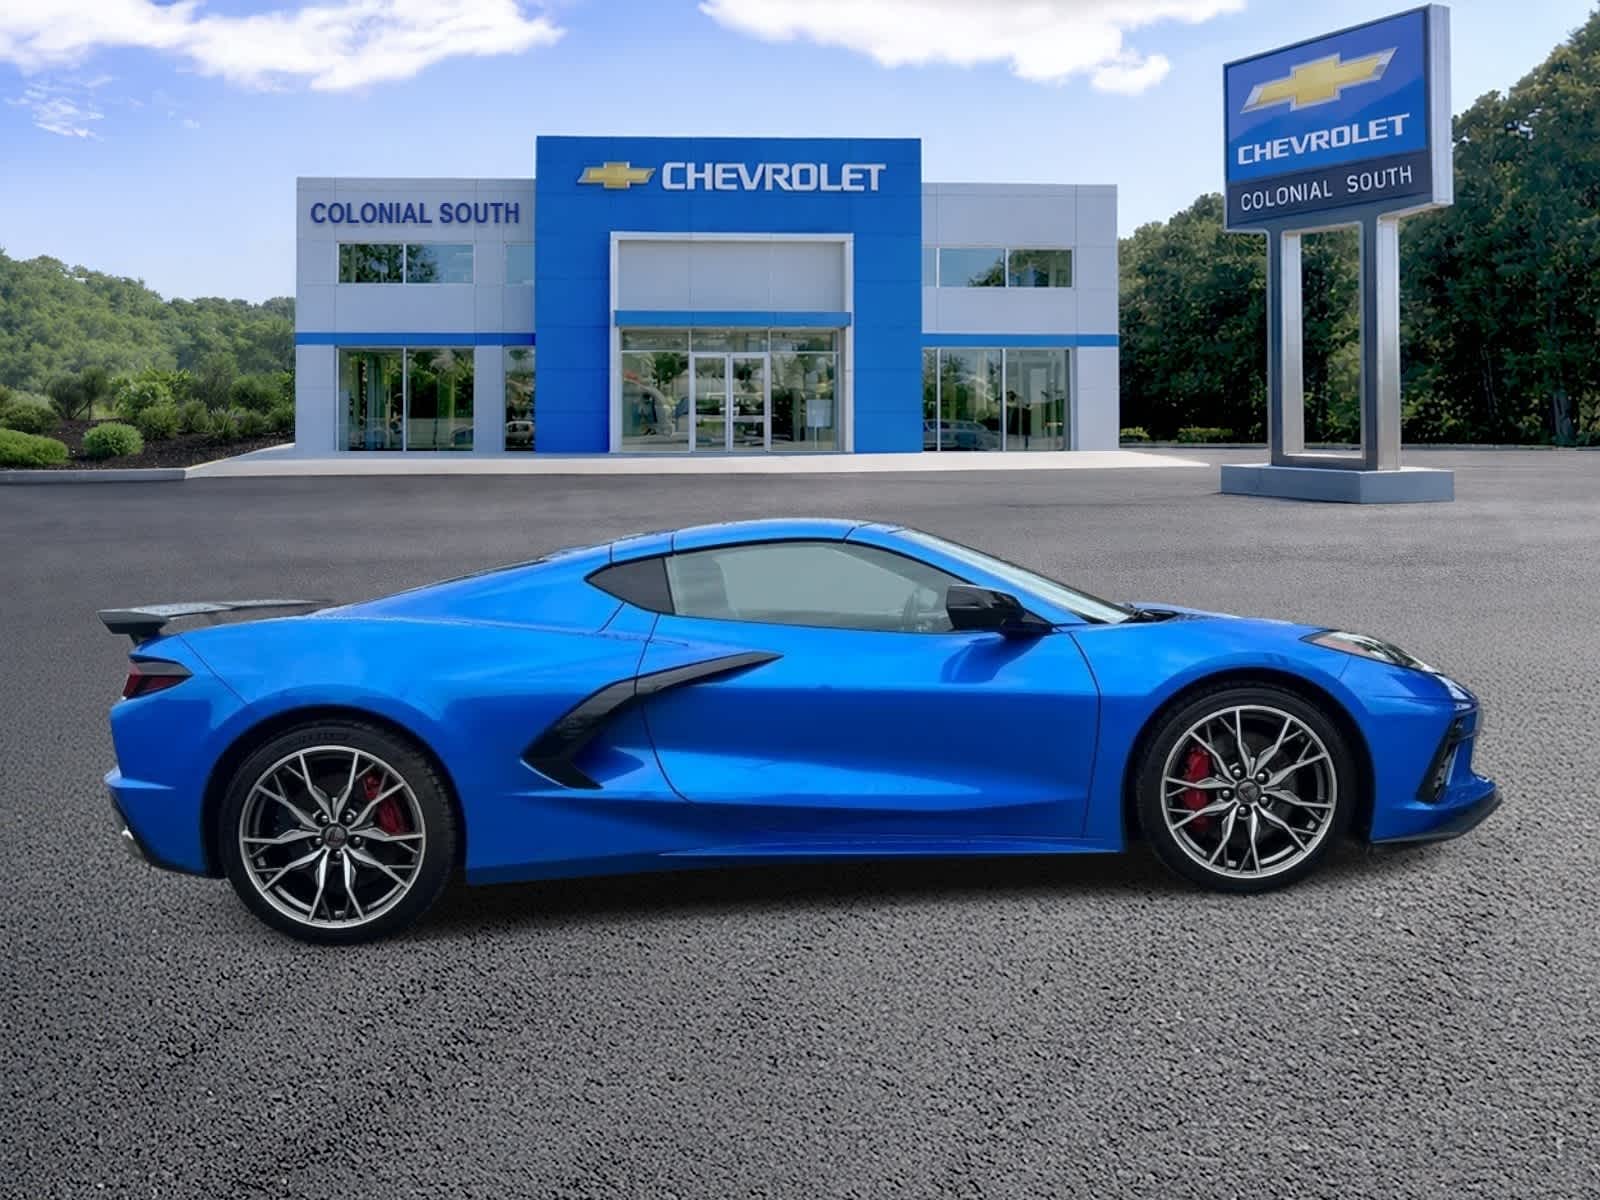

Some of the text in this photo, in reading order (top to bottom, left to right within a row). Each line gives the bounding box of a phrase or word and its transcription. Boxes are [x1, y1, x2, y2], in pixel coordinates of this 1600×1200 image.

[1238, 113, 1410, 165] CHEVROLET
[662, 162, 886, 192] CHEVROLET
[1240, 165, 1412, 211] COLONIAL SOUTH
[310, 202, 520, 224] COLONIAL SOUTH
